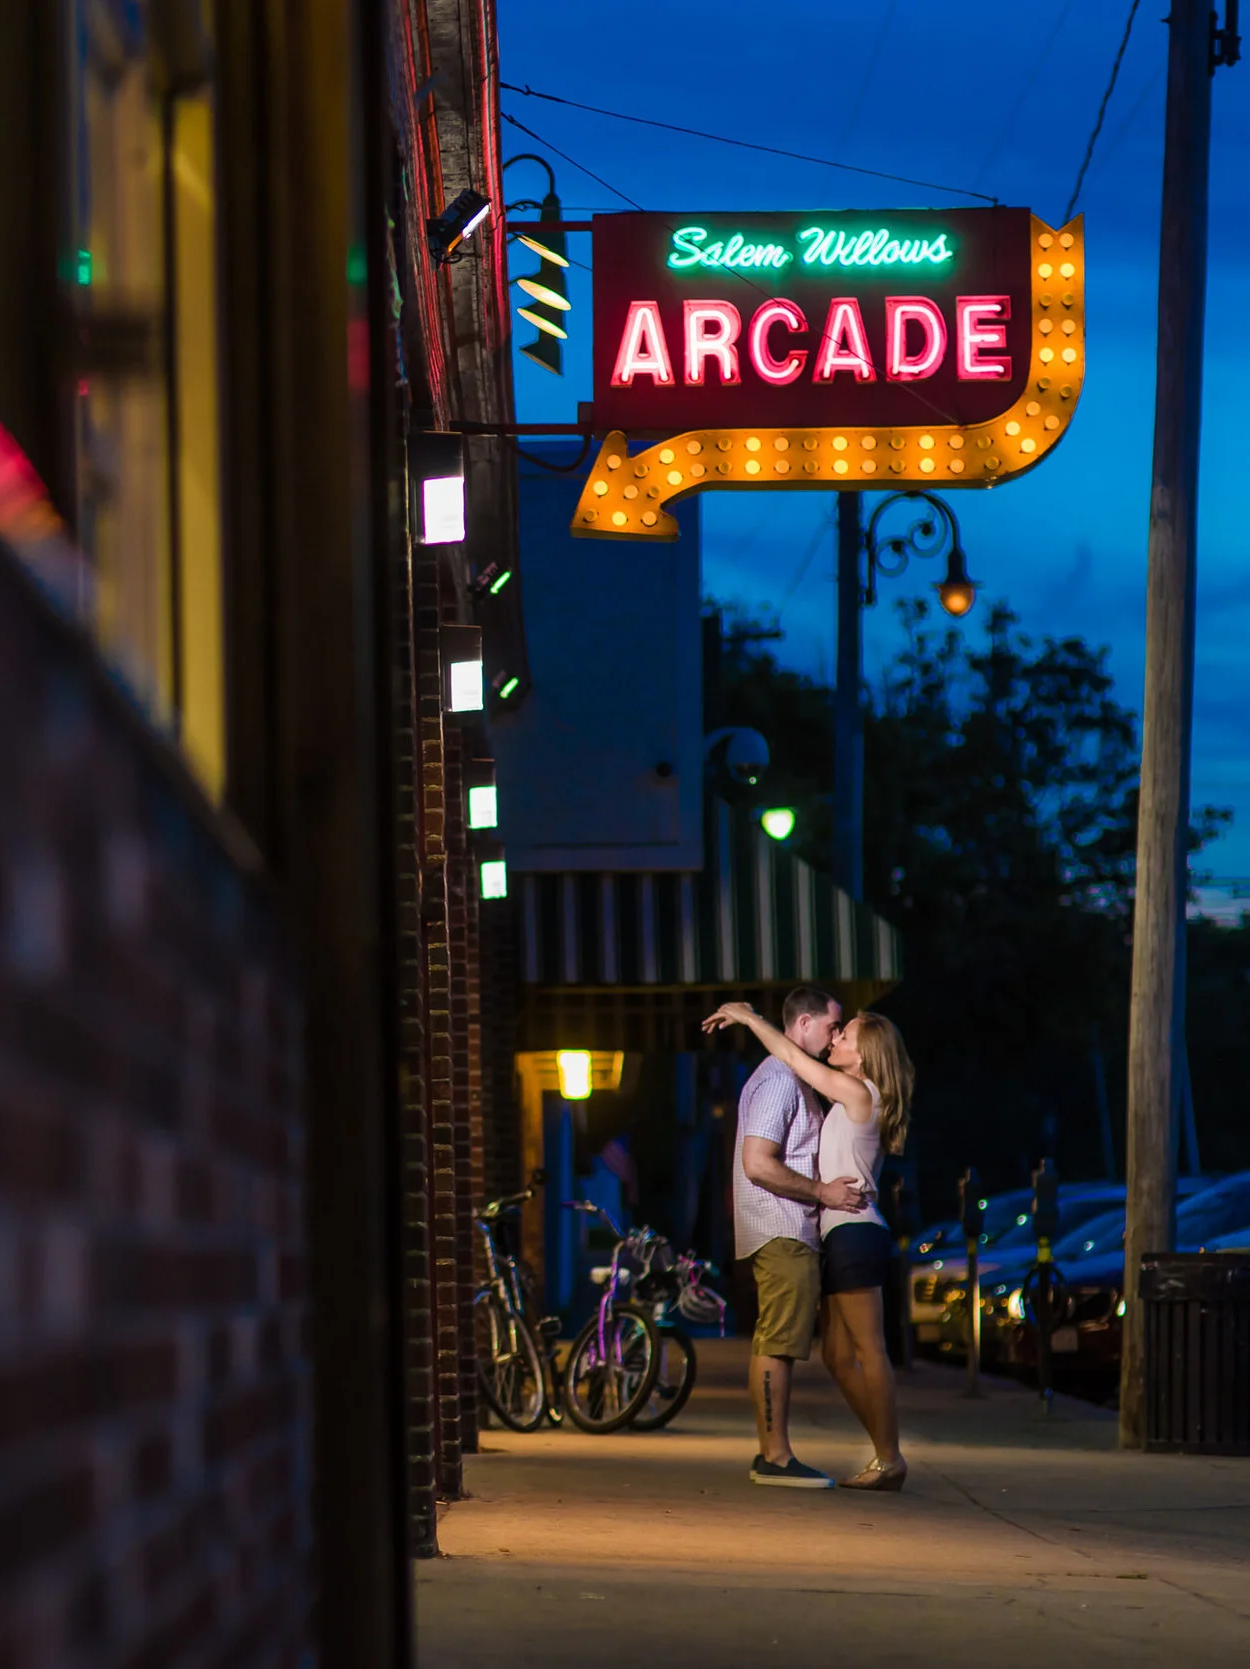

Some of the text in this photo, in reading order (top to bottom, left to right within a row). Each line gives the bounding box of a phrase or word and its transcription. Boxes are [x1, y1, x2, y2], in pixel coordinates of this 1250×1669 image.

[669, 226, 953, 269] Salem Willows
[610, 296, 1012, 386] ARCADE
